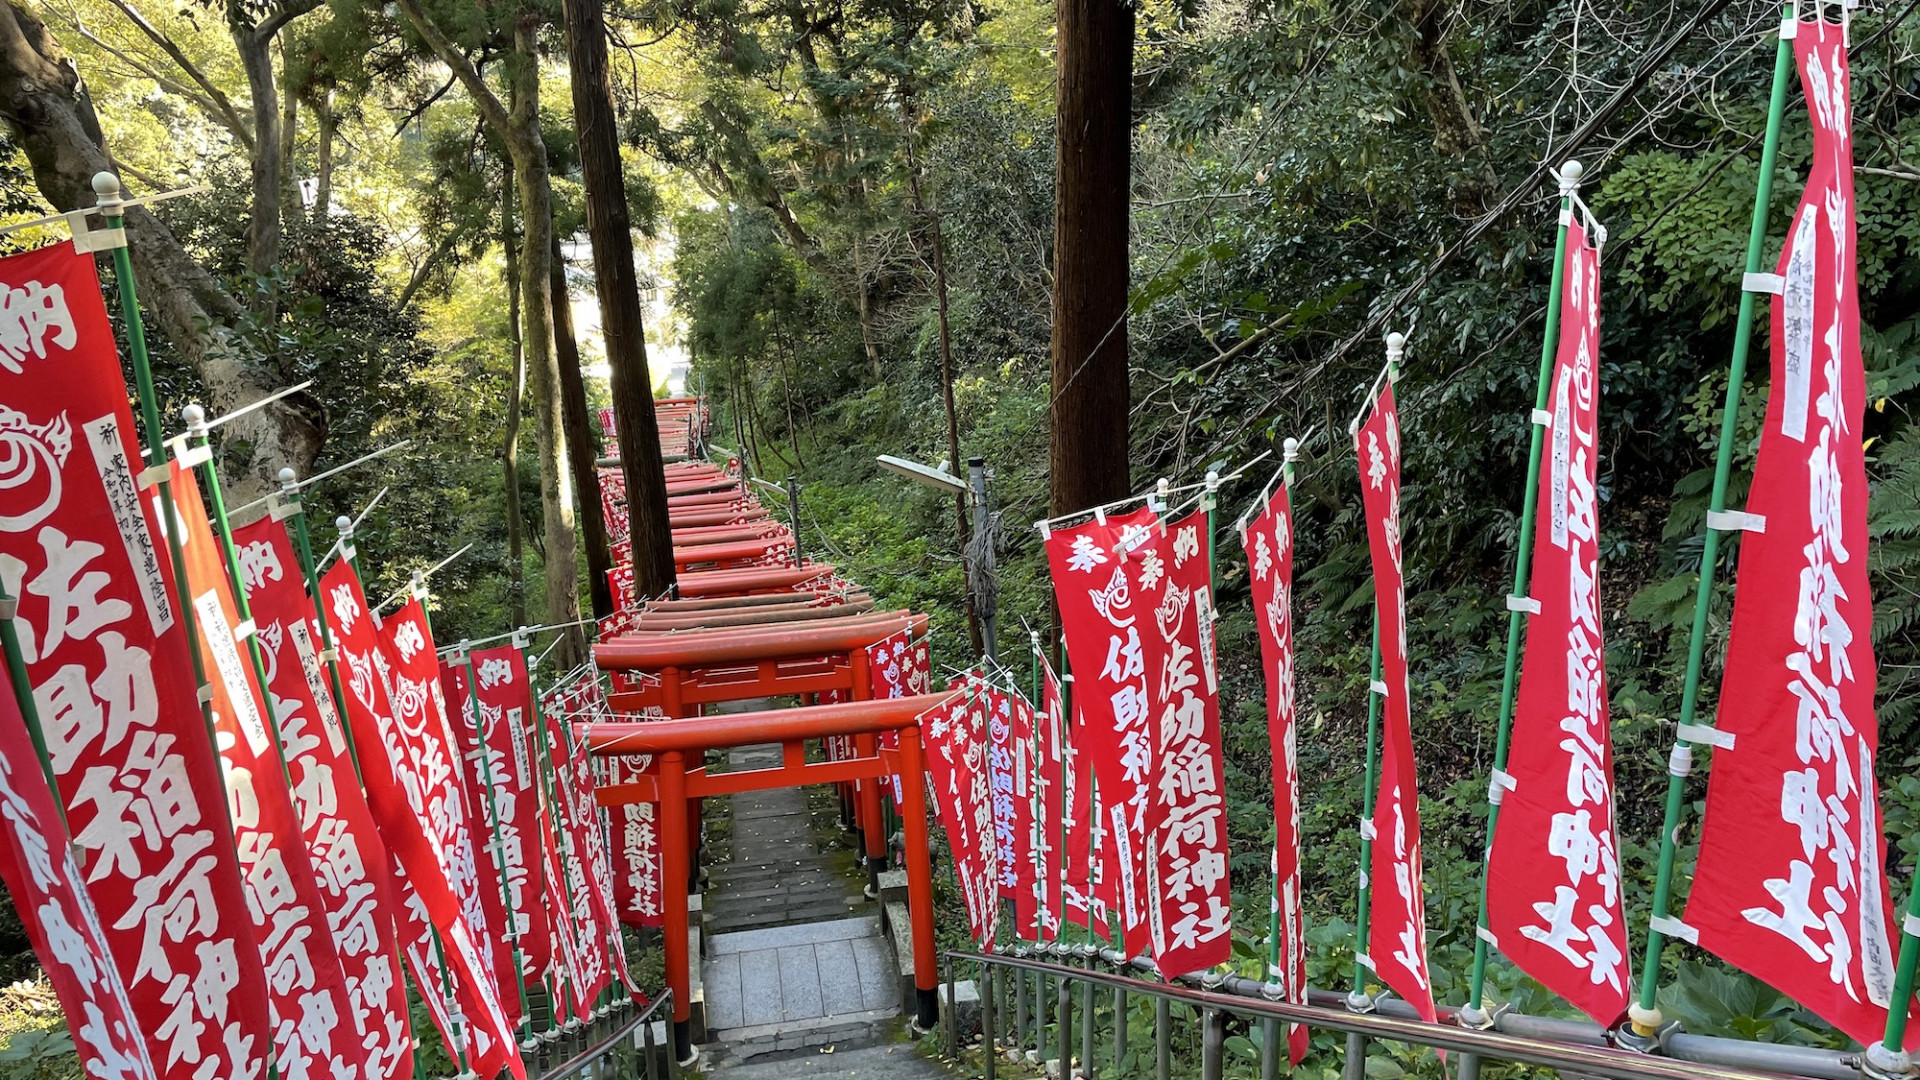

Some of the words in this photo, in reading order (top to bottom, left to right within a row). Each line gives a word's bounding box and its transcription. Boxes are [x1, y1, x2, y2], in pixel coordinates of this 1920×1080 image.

[1138, 525, 1199, 592] 奉納
[1157, 638, 1231, 951] 佐助稲荷神社
